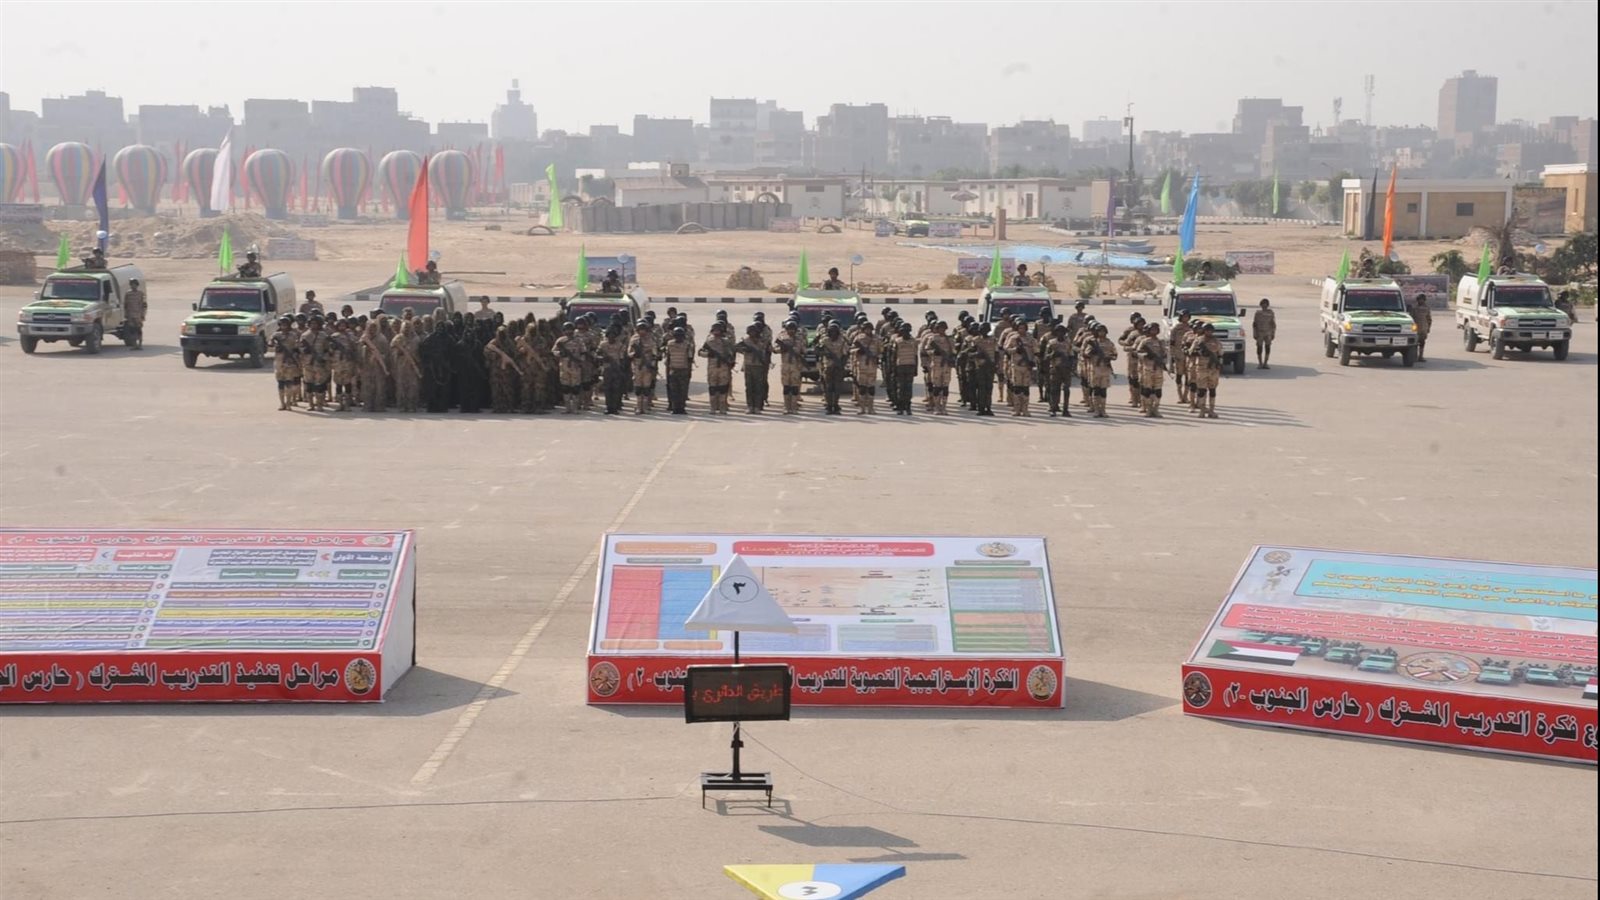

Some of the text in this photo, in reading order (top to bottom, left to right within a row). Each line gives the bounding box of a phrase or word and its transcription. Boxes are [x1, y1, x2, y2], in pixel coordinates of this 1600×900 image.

[732, 582, 746, 595] ٣
[88, 662, 157, 691] المشترك
[161, 662, 231, 691] التدريب
[235, 661, 281, 690] تنفيذ
[285, 662, 340, 691] مراحل
[797, 667, 847, 693] للتدريب
[850, 667, 900, 694] التعبوية
[904, 667, 980, 696] الإستراتيجية
[983, 668, 1019, 695] الفكرة
[1249, 687, 1309, 715] الجنوب
[1378, 696, 1450, 728] المشترك
[1454, 710, 1531, 737] التدريب
[1535, 714, 1579, 744] فكرة
